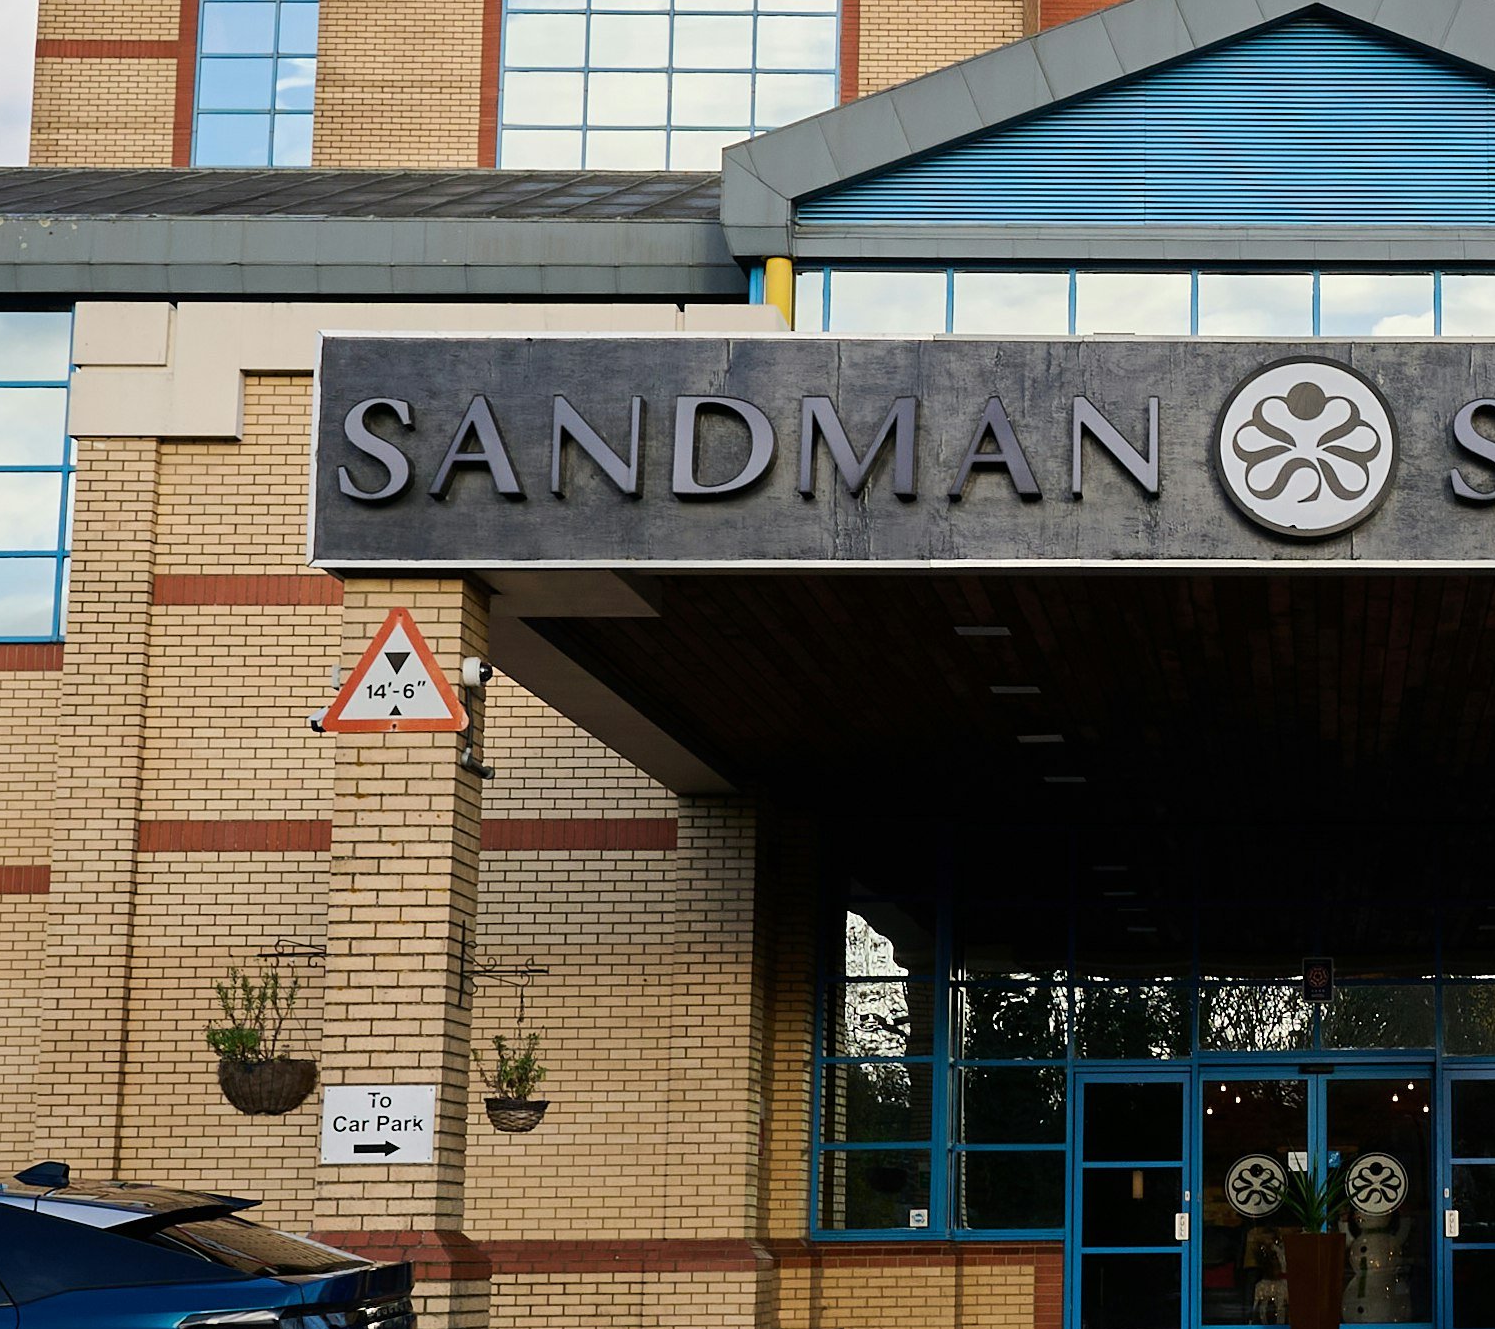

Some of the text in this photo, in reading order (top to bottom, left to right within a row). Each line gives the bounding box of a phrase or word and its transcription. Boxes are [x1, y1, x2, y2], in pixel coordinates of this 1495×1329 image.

[337, 394, 1161, 502] SANDMAN
[367, 1092, 392, 1109] To
[333, 1115, 424, 1133] Car Park
